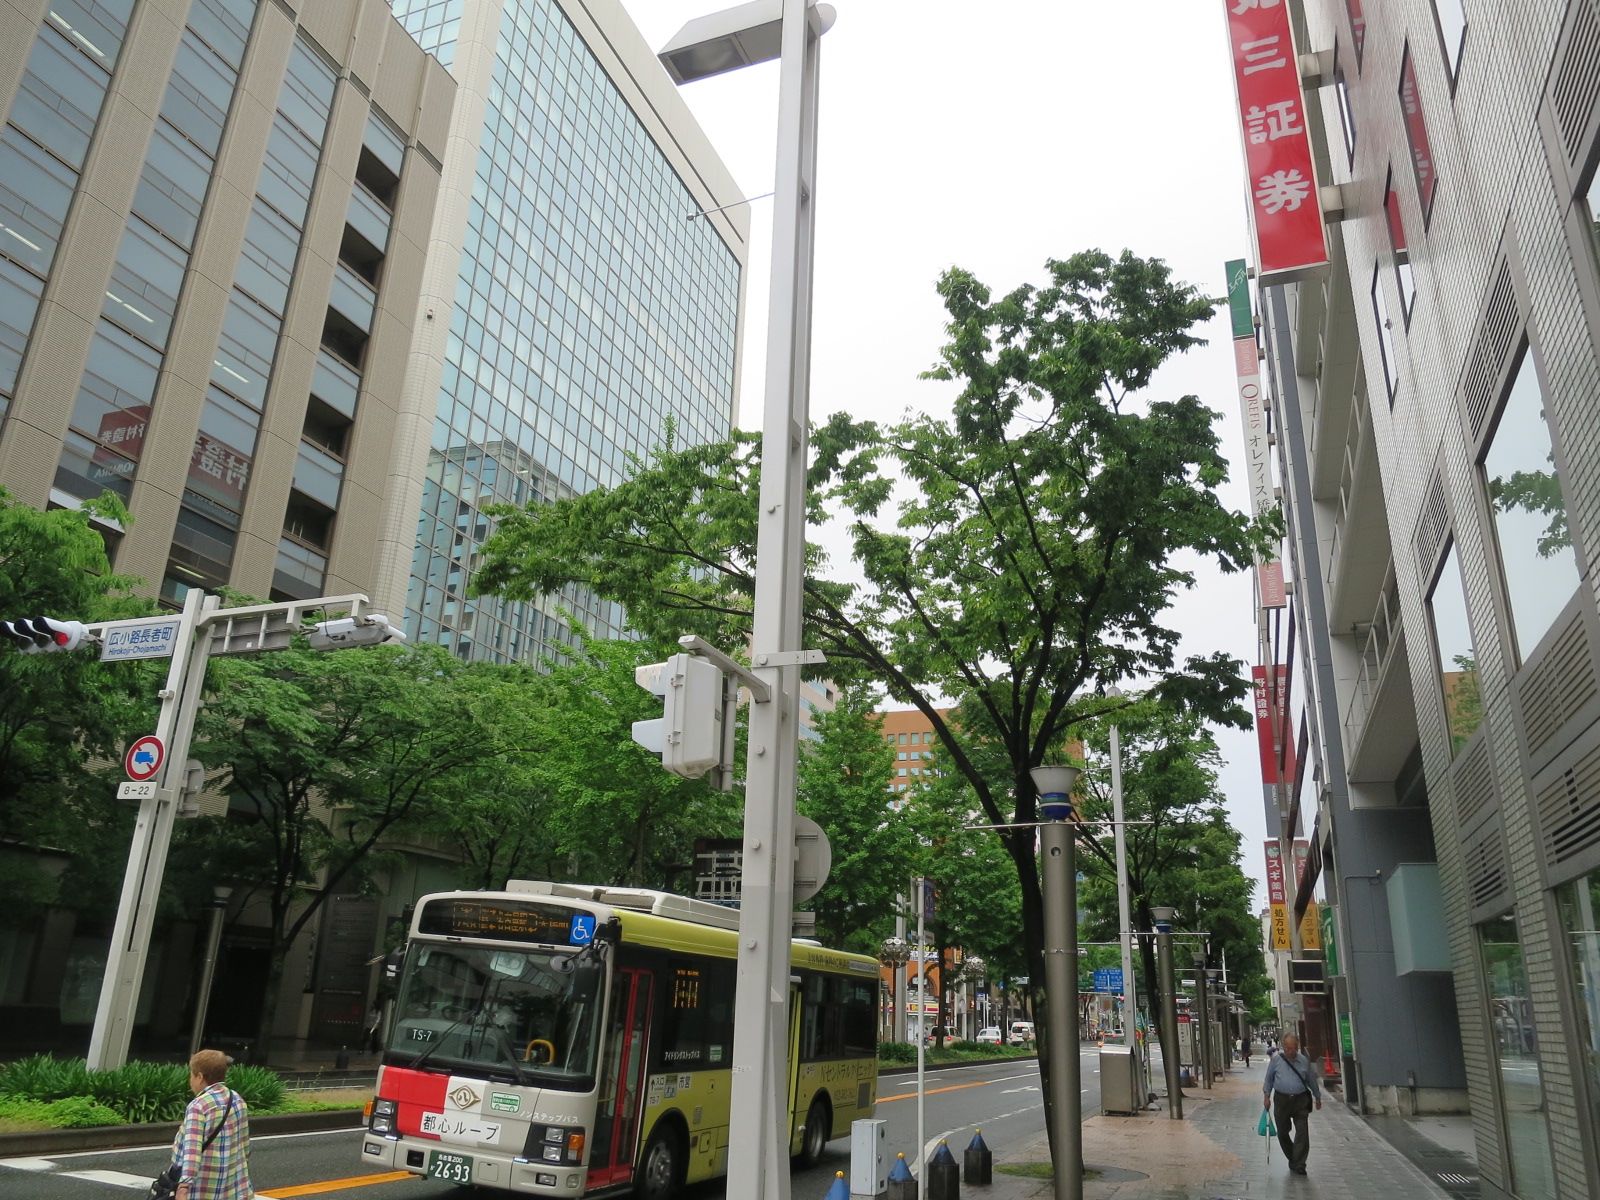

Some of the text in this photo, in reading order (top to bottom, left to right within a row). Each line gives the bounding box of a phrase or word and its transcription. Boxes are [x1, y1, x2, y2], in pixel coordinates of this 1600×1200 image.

[108, 626, 173, 645] 広小路長者町
[124, 786, 149, 795] 8-22
[1268, 859, 1283, 901] スギ薬局
[1274, 908, 1286, 945] 処方せん
[412, 1029, 433, 1042] TS-7
[519, 1110, 579, 1124] ノンステップバス
[423, 1114, 500, 1140] 都心ループ
